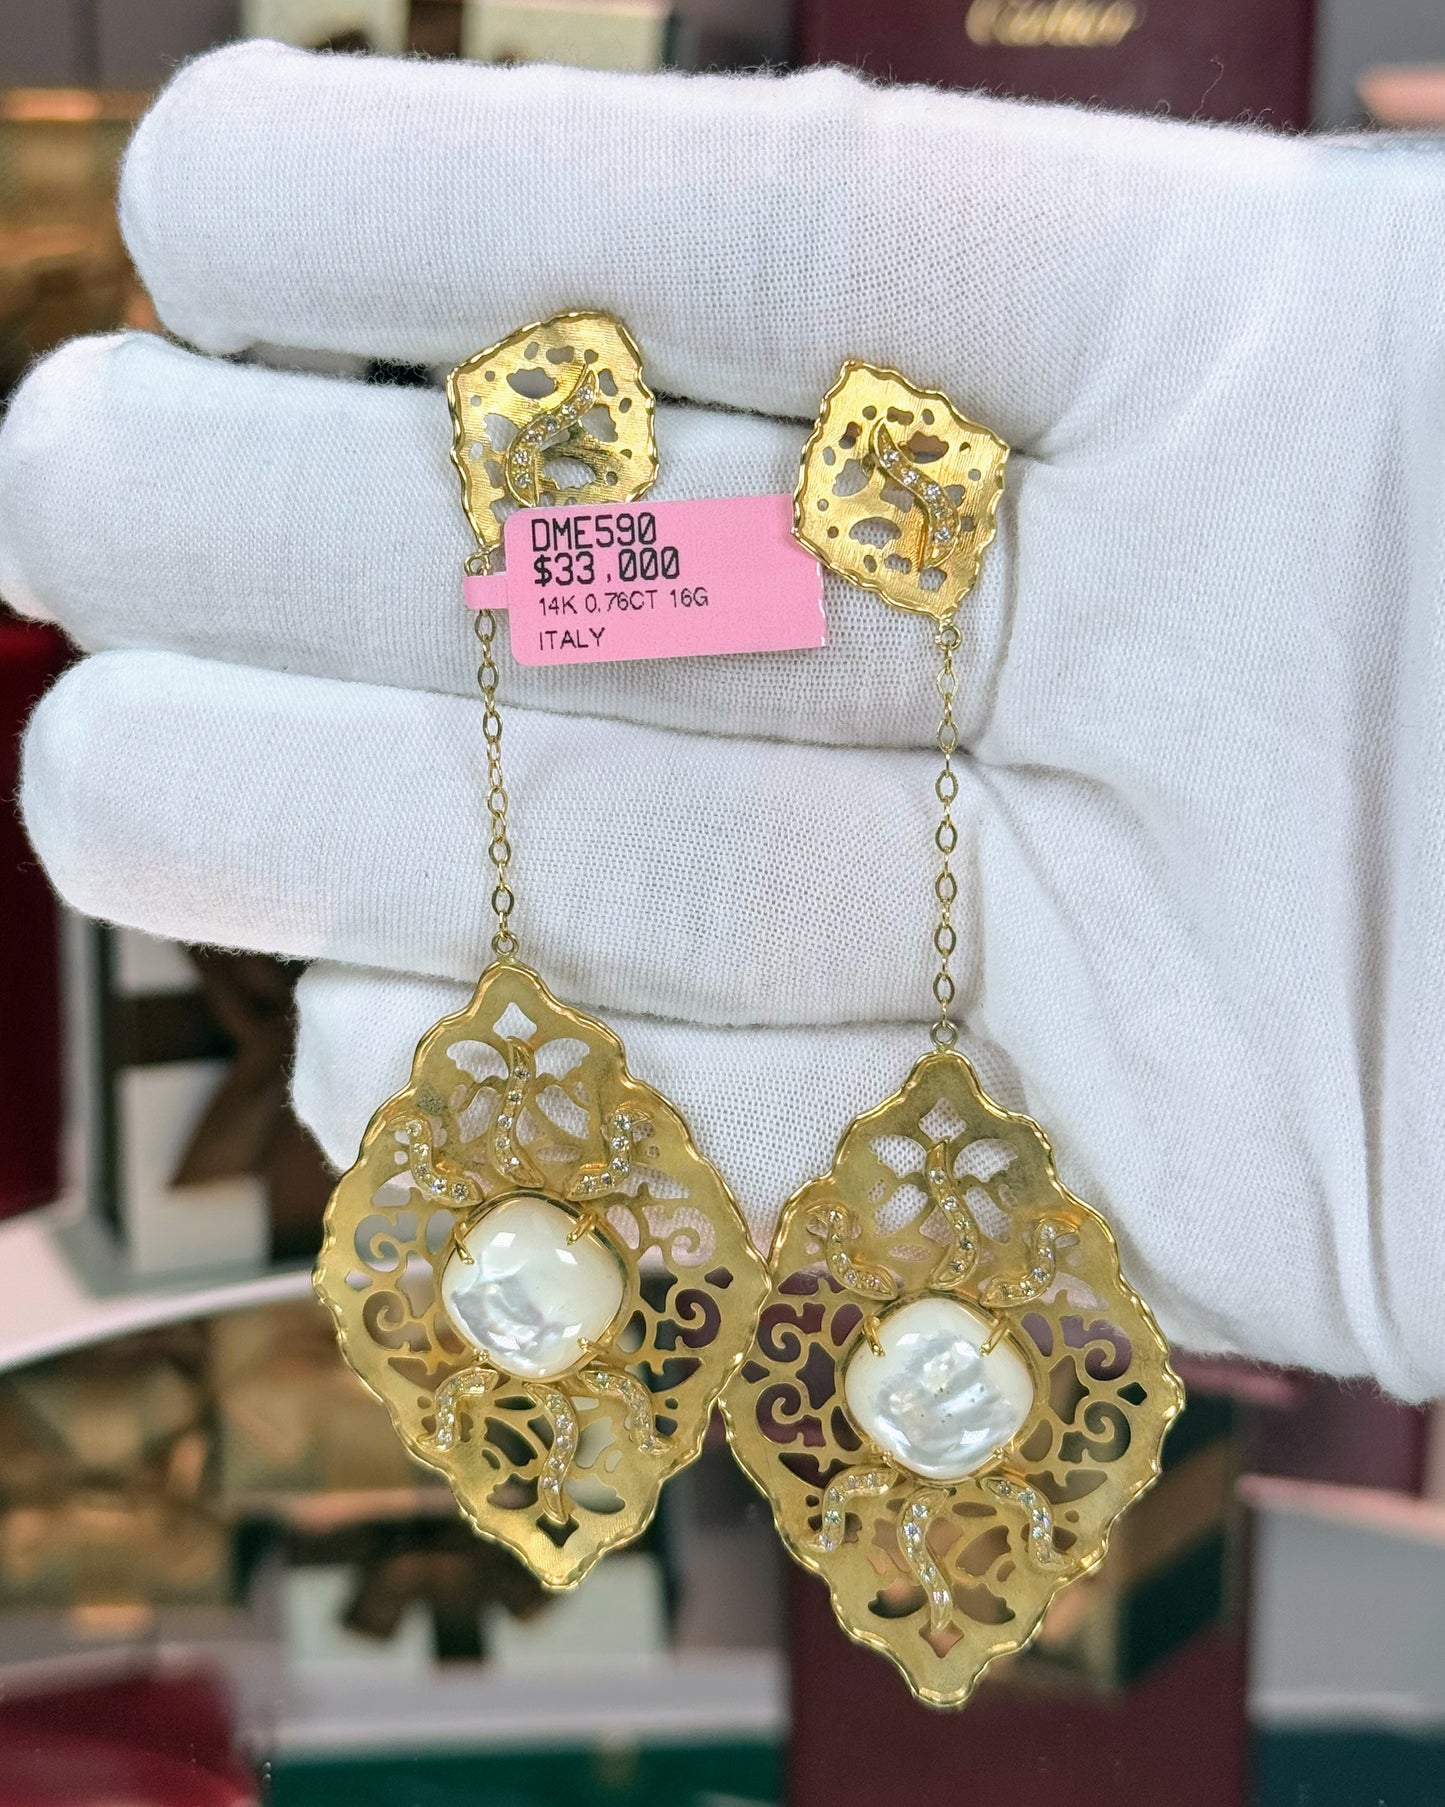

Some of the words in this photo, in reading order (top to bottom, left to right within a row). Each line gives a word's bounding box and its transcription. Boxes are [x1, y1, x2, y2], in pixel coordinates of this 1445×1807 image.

[531, 512, 656, 552] DME590
[533, 546, 680, 587] $33,000
[538, 595, 577, 616] 14K
[585, 589, 658, 613] 0.76CT
[670, 587, 709, 608] 16G
[539, 627, 606, 651] ITALY
